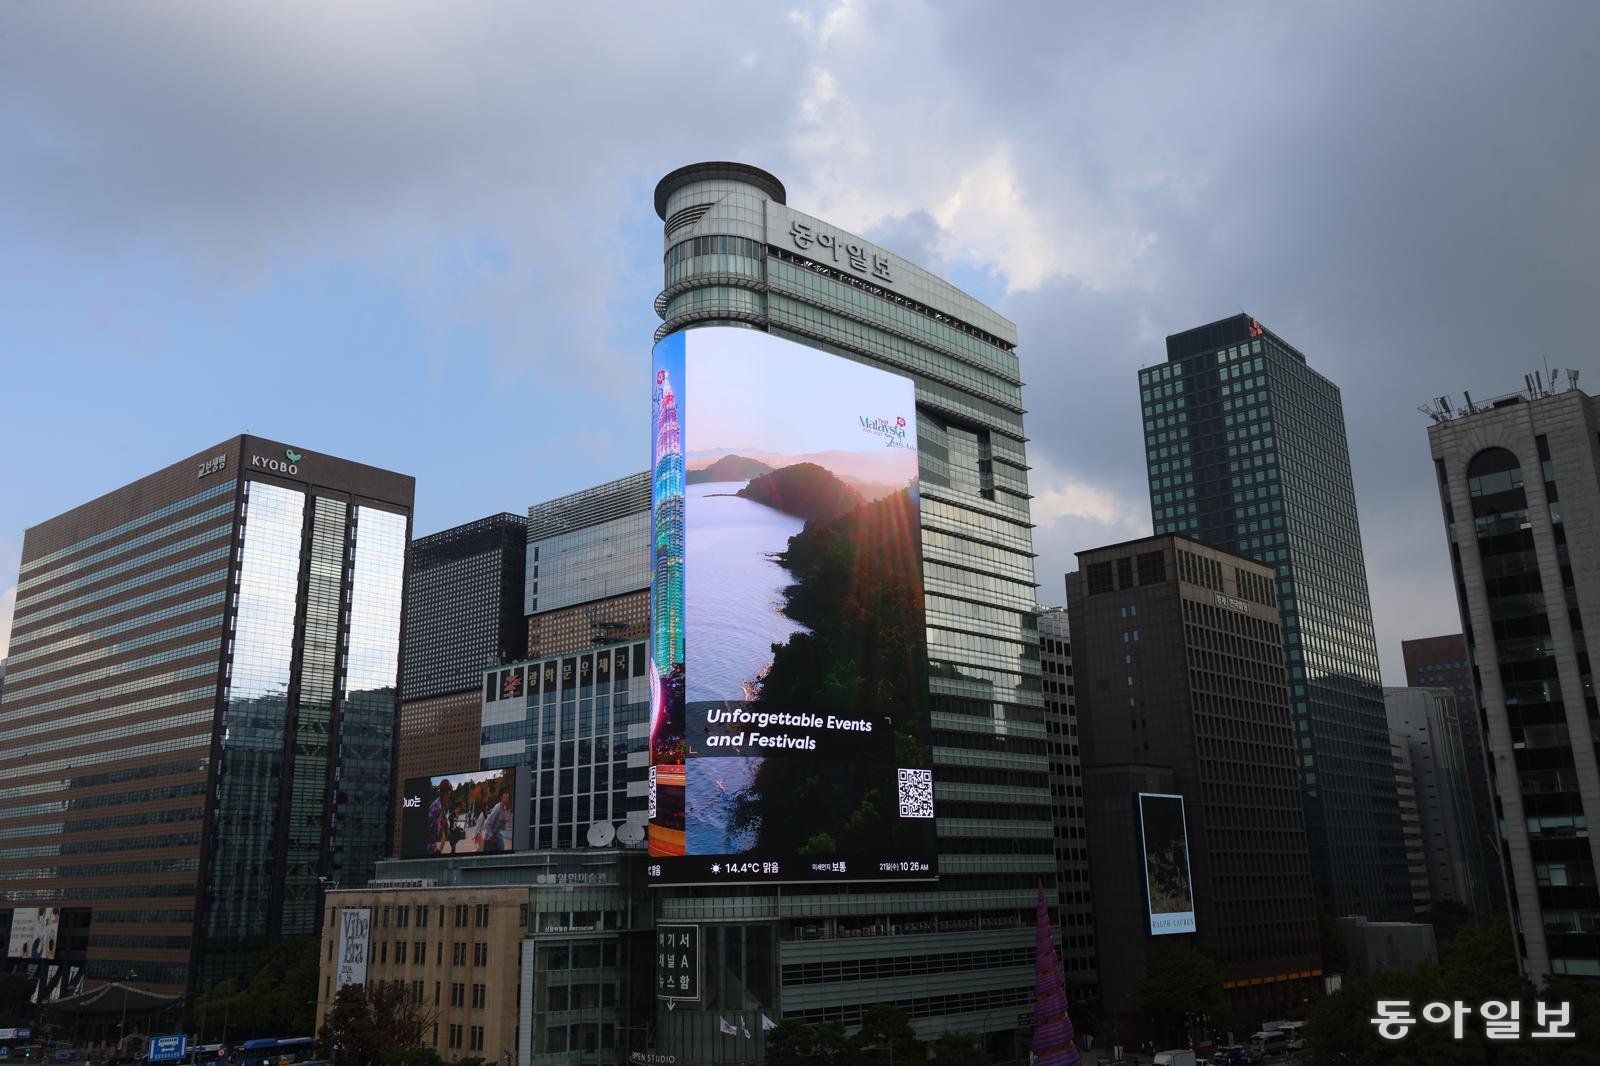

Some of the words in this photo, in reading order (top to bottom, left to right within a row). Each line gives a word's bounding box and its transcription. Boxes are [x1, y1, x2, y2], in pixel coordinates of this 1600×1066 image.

[789, 220, 894, 283] 동아일보
[859, 415, 906, 439] Malaysia
[197, 454, 226, 479] 교보생명
[252, 455, 298, 475] KYOBO
[528, 654, 626, 687] 광화문우체국
[706, 708, 824, 728] Unforgettable
[826, 715, 873, 732] Events
[706, 732, 745, 747] and
[748, 732, 816, 750] Festivals
[762, 861, 779, 874] 맑음
[811, 863, 831, 871] 미세먼지
[832, 861, 847, 873] 보통
[920, 863, 929, 871] AM
[342, 911, 369, 939] Vibe
[659, 933, 690, 948] 여기서
[659, 953, 689, 969] 채널A
[658, 975, 691, 990] 뉴스함
[647, 1054, 676, 1064] STUDIO
